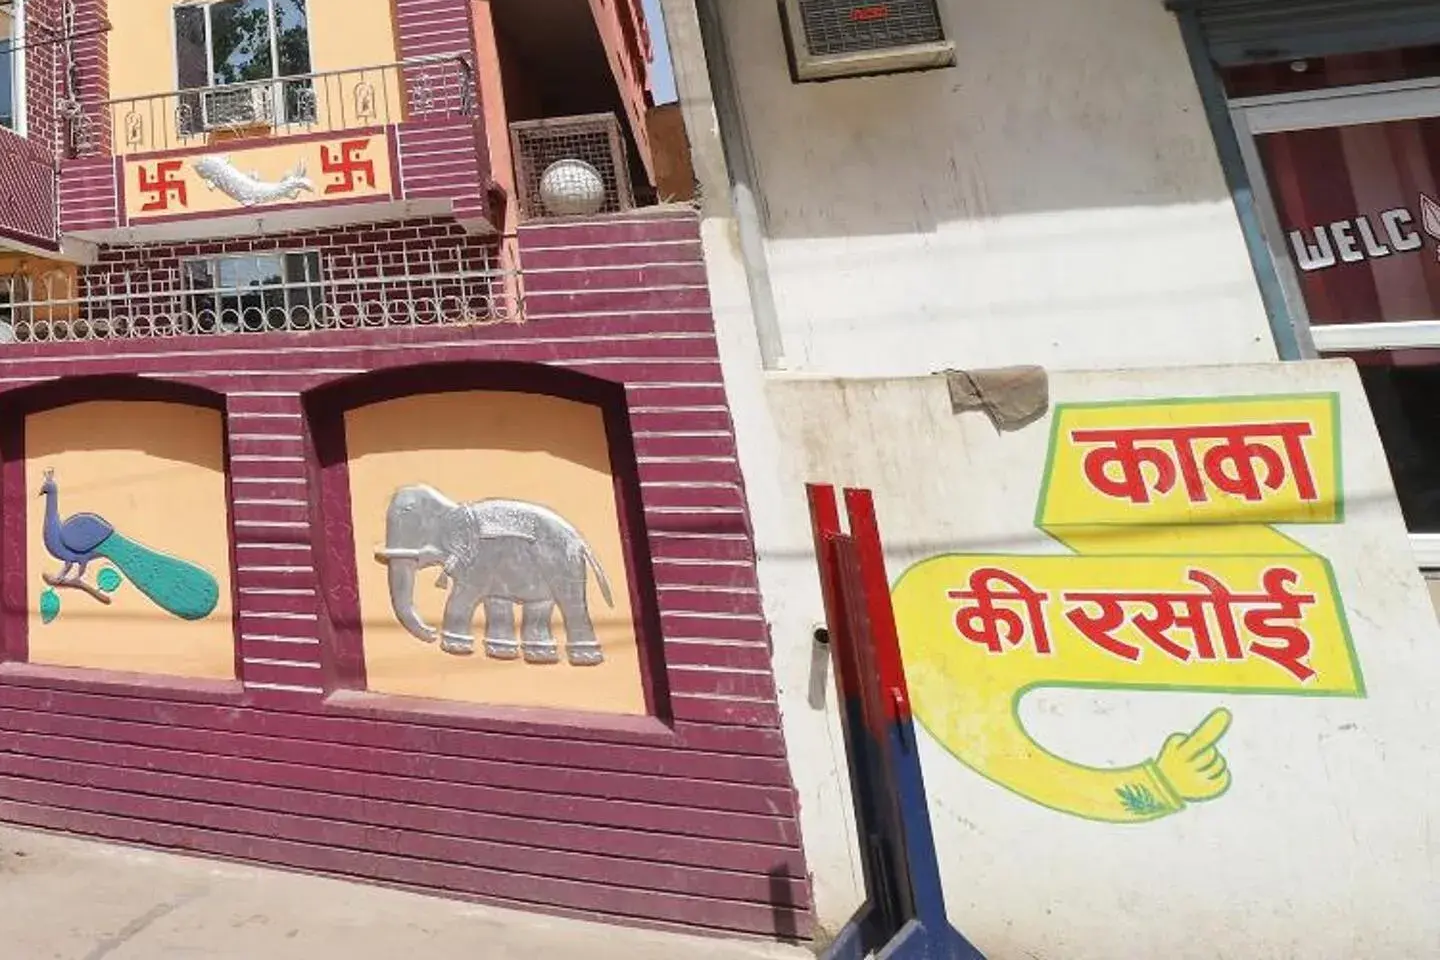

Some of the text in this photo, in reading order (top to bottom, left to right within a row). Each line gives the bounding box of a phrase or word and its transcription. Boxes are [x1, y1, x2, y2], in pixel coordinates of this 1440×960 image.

[1071, 422, 1318, 504] काका
[948, 567, 1318, 682] की रसोई
